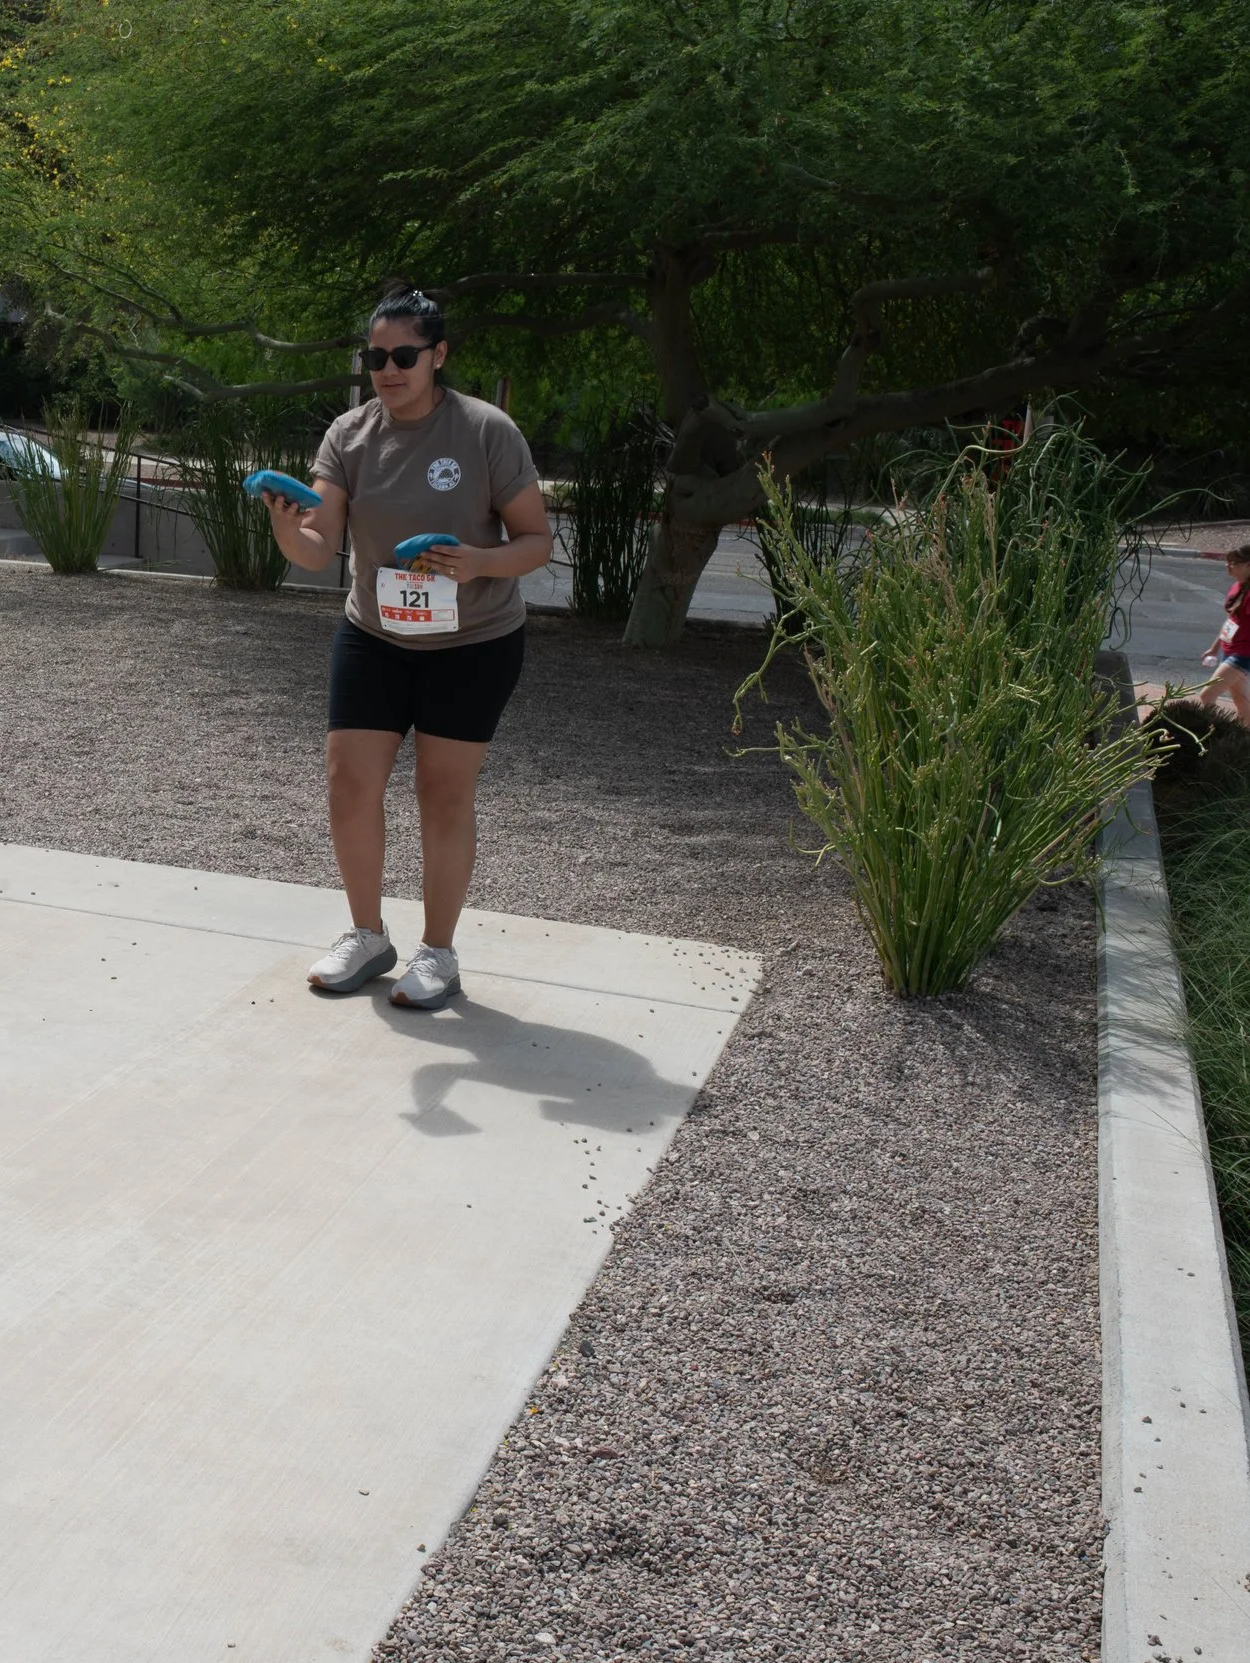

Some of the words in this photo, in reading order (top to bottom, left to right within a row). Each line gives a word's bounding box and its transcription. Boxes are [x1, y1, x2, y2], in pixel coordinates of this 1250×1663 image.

[395, 572, 407, 581] THE
[408, 573, 425, 582] TACO
[399, 590, 430, 608] 121
